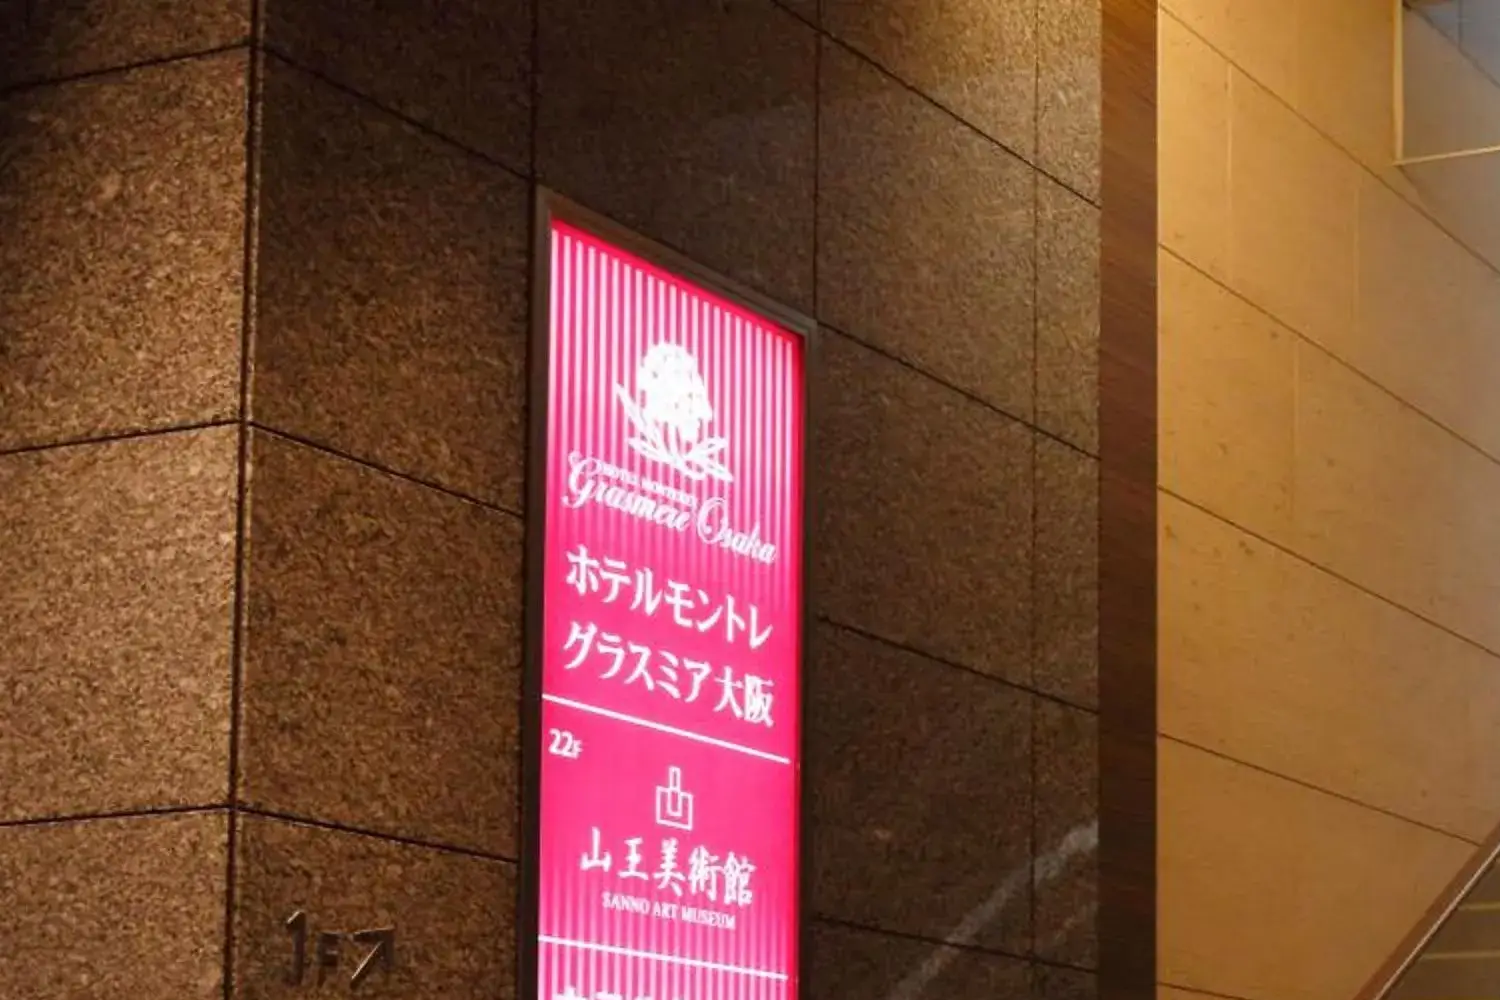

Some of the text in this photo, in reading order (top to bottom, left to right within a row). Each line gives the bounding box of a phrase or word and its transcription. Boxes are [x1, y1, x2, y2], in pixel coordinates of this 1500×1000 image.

[697, 497, 777, 565] Osaka
[565, 544, 773, 650] ホテルモントレ
[563, 619, 775, 728] グラスミア大阪
[549, 728, 583, 759] 22F
[579, 826, 756, 907] 山王美術館
[602, 891, 736, 930] SANNO ART MUSEUM
